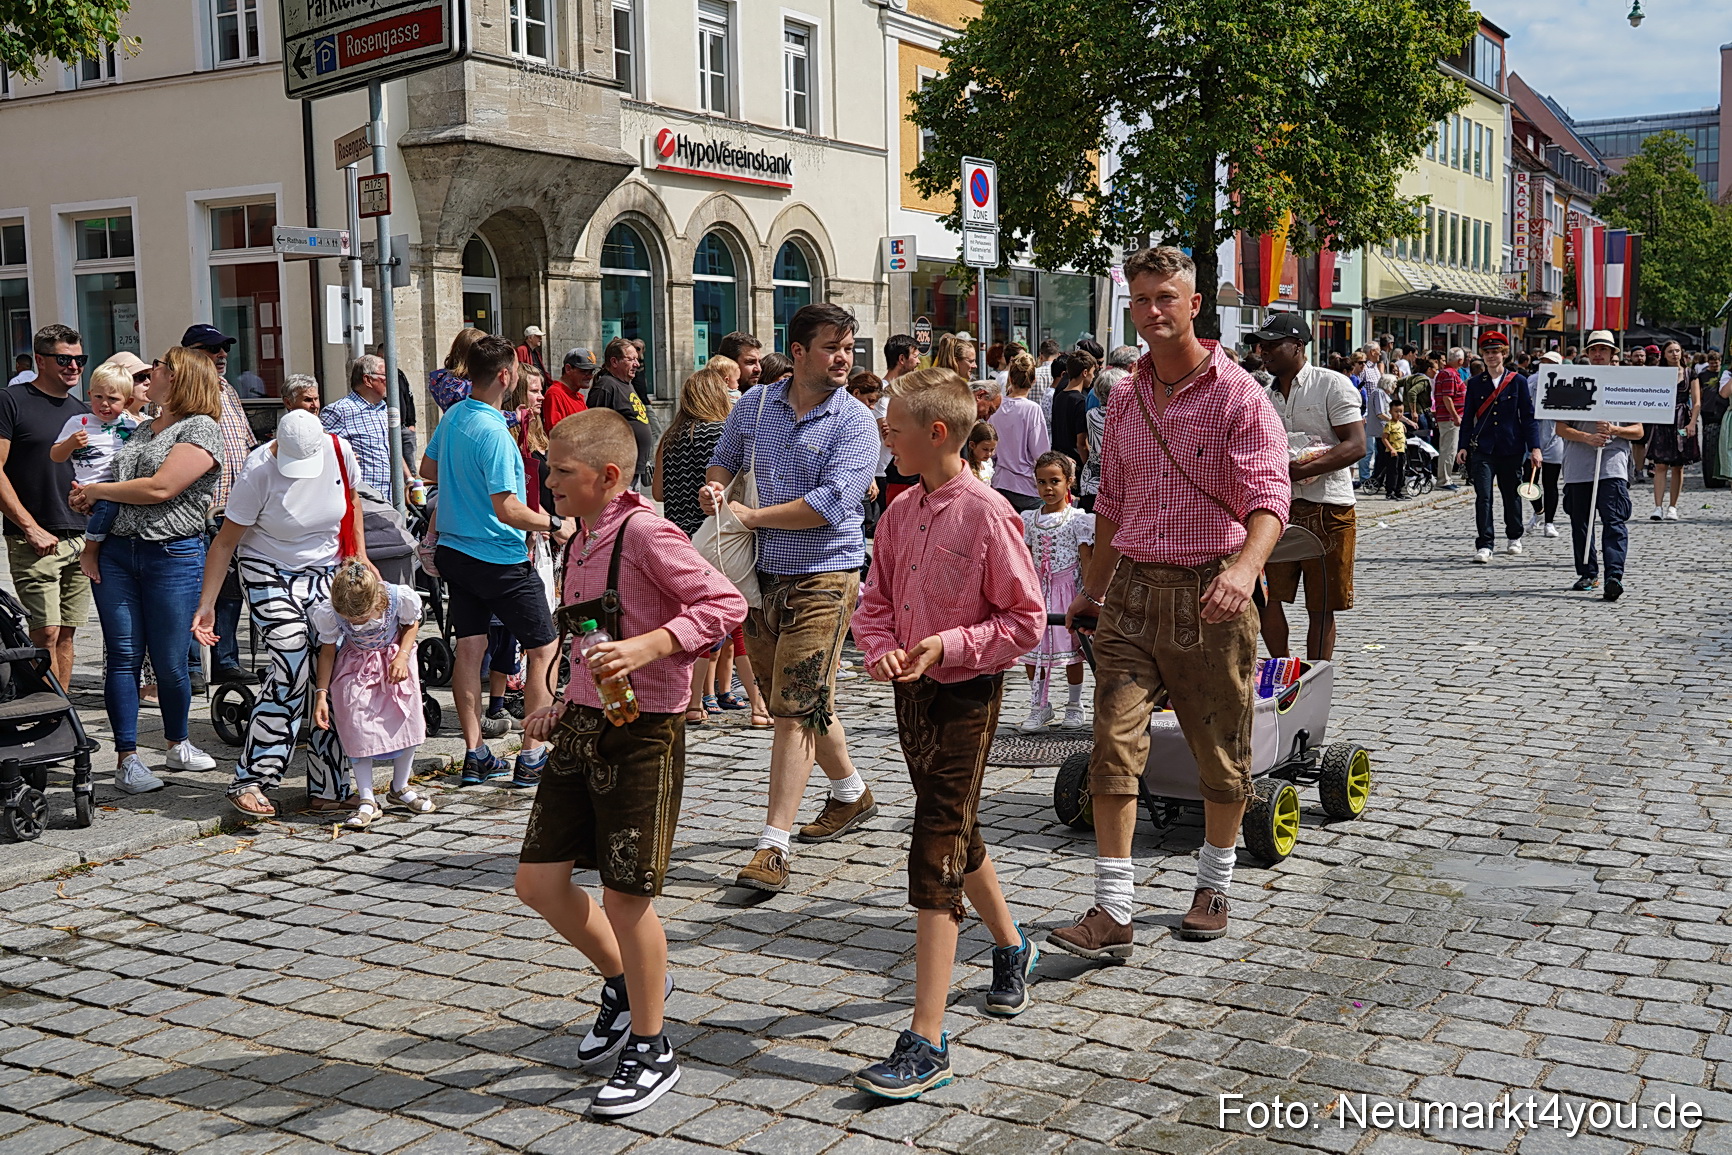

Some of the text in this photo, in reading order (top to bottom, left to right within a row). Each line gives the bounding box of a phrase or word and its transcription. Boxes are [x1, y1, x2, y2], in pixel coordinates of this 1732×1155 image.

[345, 23, 420, 58] Rosengasse
[337, 136, 371, 160] Rosengass
[676, 133, 792, 176] HypoVereinsbank
[364, 179, 382, 190] H175
[973, 209, 988, 220] ZONE
[286, 236, 308, 245] Rathaus
[915, 330, 930, 343] 20%
[1604, 386, 1670, 394] Modelleisenbahnclub
